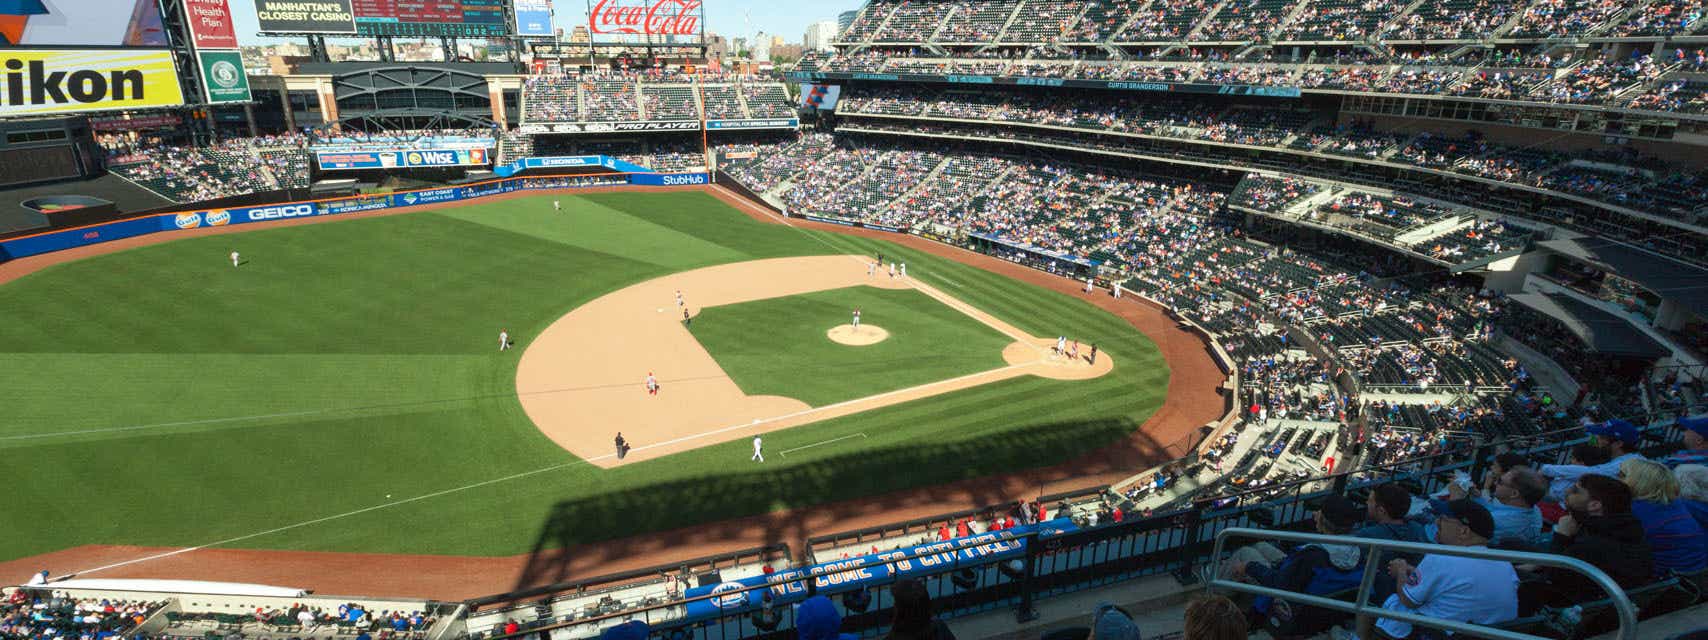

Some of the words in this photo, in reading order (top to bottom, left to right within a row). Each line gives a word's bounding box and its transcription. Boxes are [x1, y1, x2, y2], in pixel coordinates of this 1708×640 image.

[193, 5, 226, 17] Health
[265, 2, 342, 12] MANHATTAN'S
[259, 11, 308, 20] CLOSEST
[311, 12, 351, 21] CASINO
[202, 17, 223, 27] Plan
[0, 58, 144, 106] ikon
[1129, 83, 1169, 91] GRANDERSON
[647, 122, 698, 130] PLAYER
[421, 151, 455, 164] WISE
[663, 175, 704, 185] StubHub
[248, 204, 313, 220] GEICO
[766, 559, 873, 596] WELCOME
[876, 551, 912, 574] TO
[957, 530, 1022, 558] FIELD
